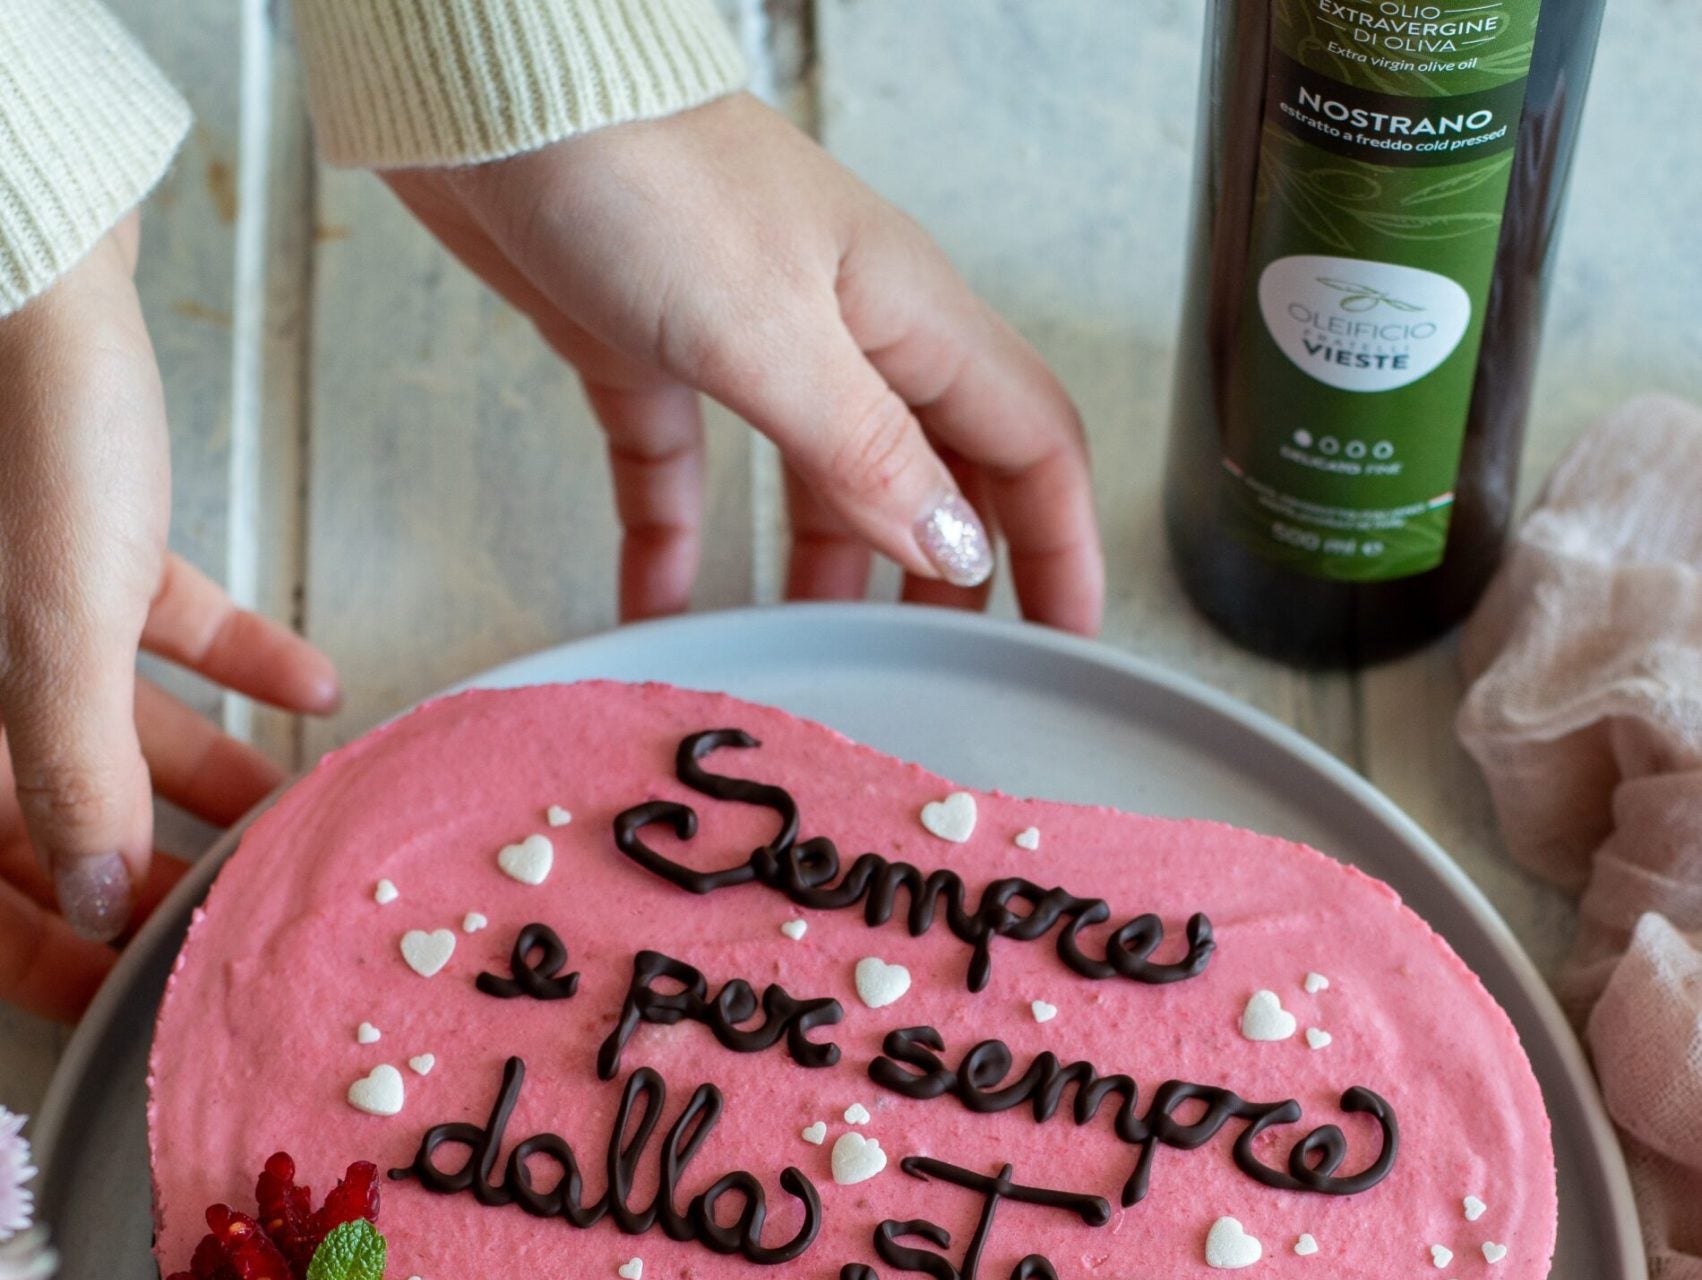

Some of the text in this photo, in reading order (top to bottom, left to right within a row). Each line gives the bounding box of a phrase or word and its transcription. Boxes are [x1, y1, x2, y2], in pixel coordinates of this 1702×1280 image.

[1319, 0, 1499, 37] EXTRAVERGINE
[1380, 2, 1441, 20] OLIO
[1328, 41, 1478, 72] Extra virgin olive oil
[1354, 28, 1457, 52] DI OLIVA
[1280, 102, 1507, 152] estratto a freddo cold pressed
[1299, 86, 1493, 136] NOSTRANO
[1288, 303, 1437, 341] OLEIFICIO
[1302, 338, 1410, 370] VIESTE
[612, 727, 1216, 995] Sempre
[474, 922, 1398, 1208] e per sempre
[387, 1056, 822, 1265] dalla
